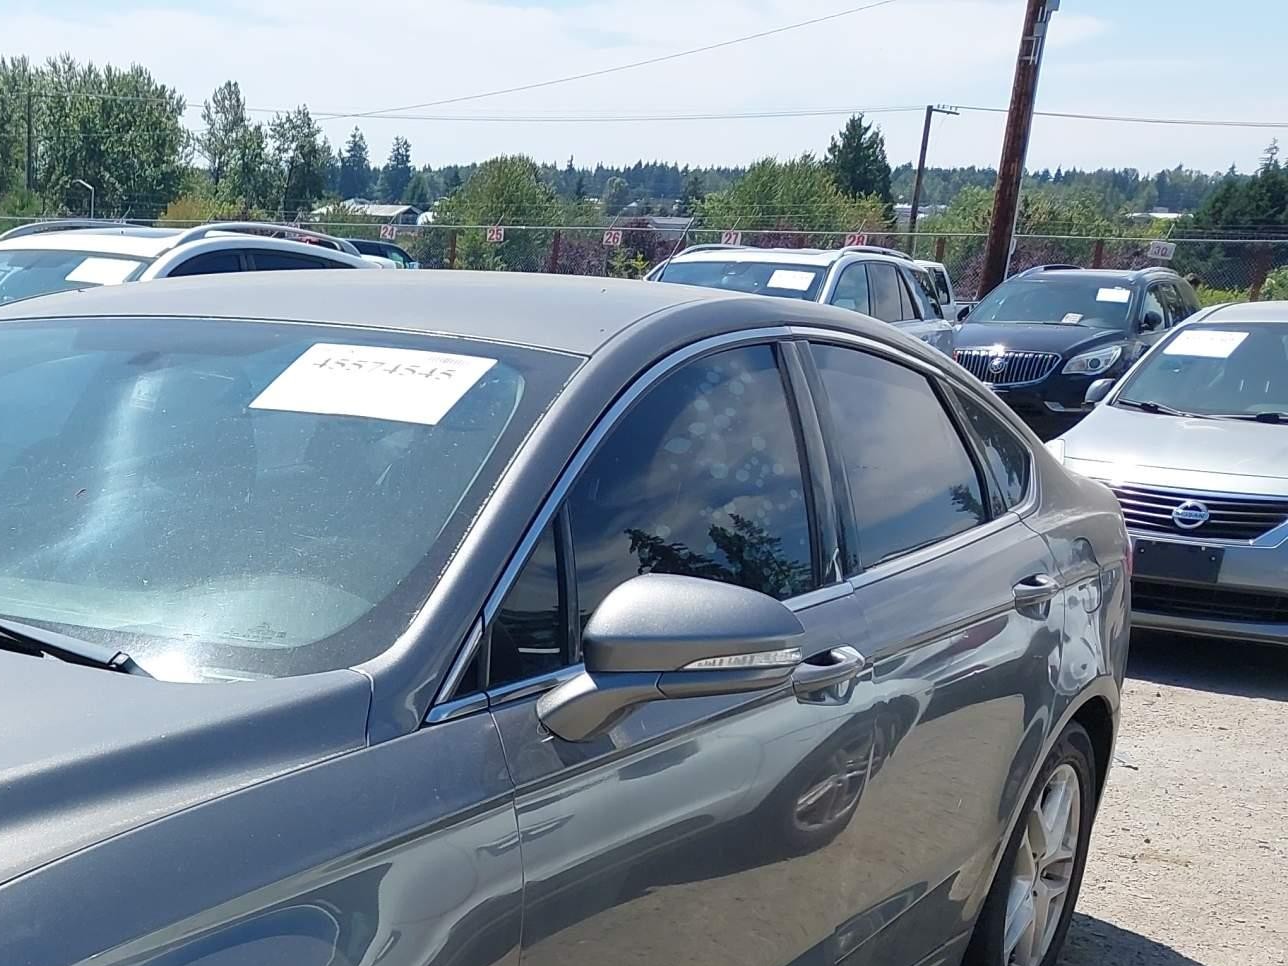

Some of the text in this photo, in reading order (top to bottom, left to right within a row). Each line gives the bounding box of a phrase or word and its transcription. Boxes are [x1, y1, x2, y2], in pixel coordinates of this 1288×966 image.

[382, 226, 394, 238] 24
[488, 229, 502, 240] 25
[605, 231, 620, 244] 26
[724, 231, 738, 245] 27
[847, 235, 865, 246] 28
